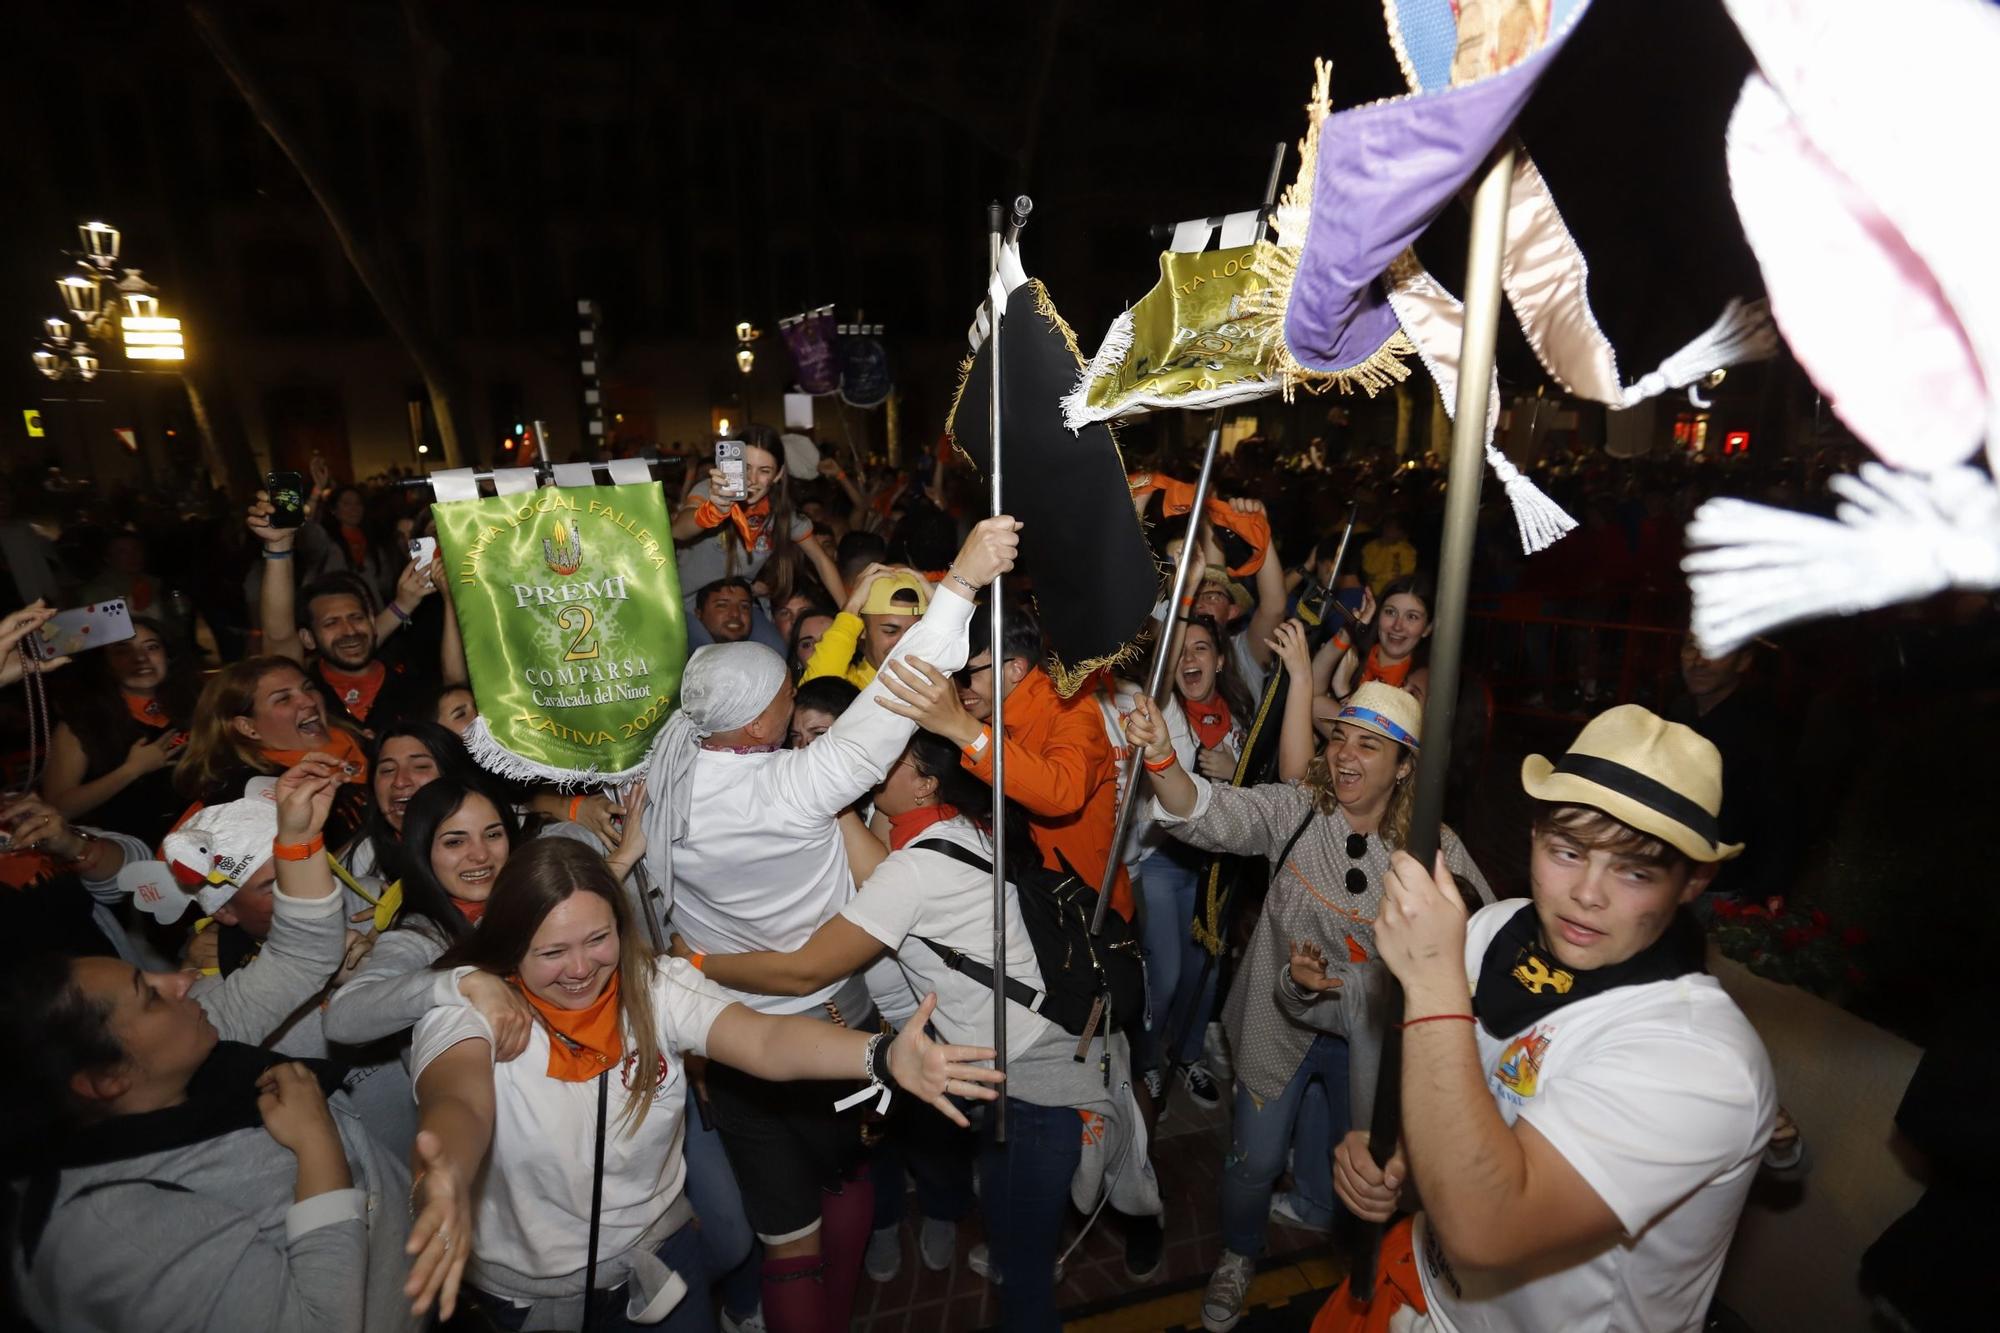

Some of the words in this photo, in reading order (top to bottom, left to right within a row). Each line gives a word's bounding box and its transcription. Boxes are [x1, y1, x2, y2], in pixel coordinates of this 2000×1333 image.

[1212, 253, 1252, 278] LOC
[460, 525, 505, 587] JUNTA
[503, 495, 583, 528] LOCAL
[588, 499, 667, 571] FALLERA
[511, 576, 630, 607] PREMI
[556, 604, 600, 663] 2
[525, 658, 649, 687] COMPARSA
[532, 687, 593, 709] Cavalcada
[594, 687, 614, 704] del
[615, 682, 651, 701] Ninot
[619, 694, 672, 741] 2023
